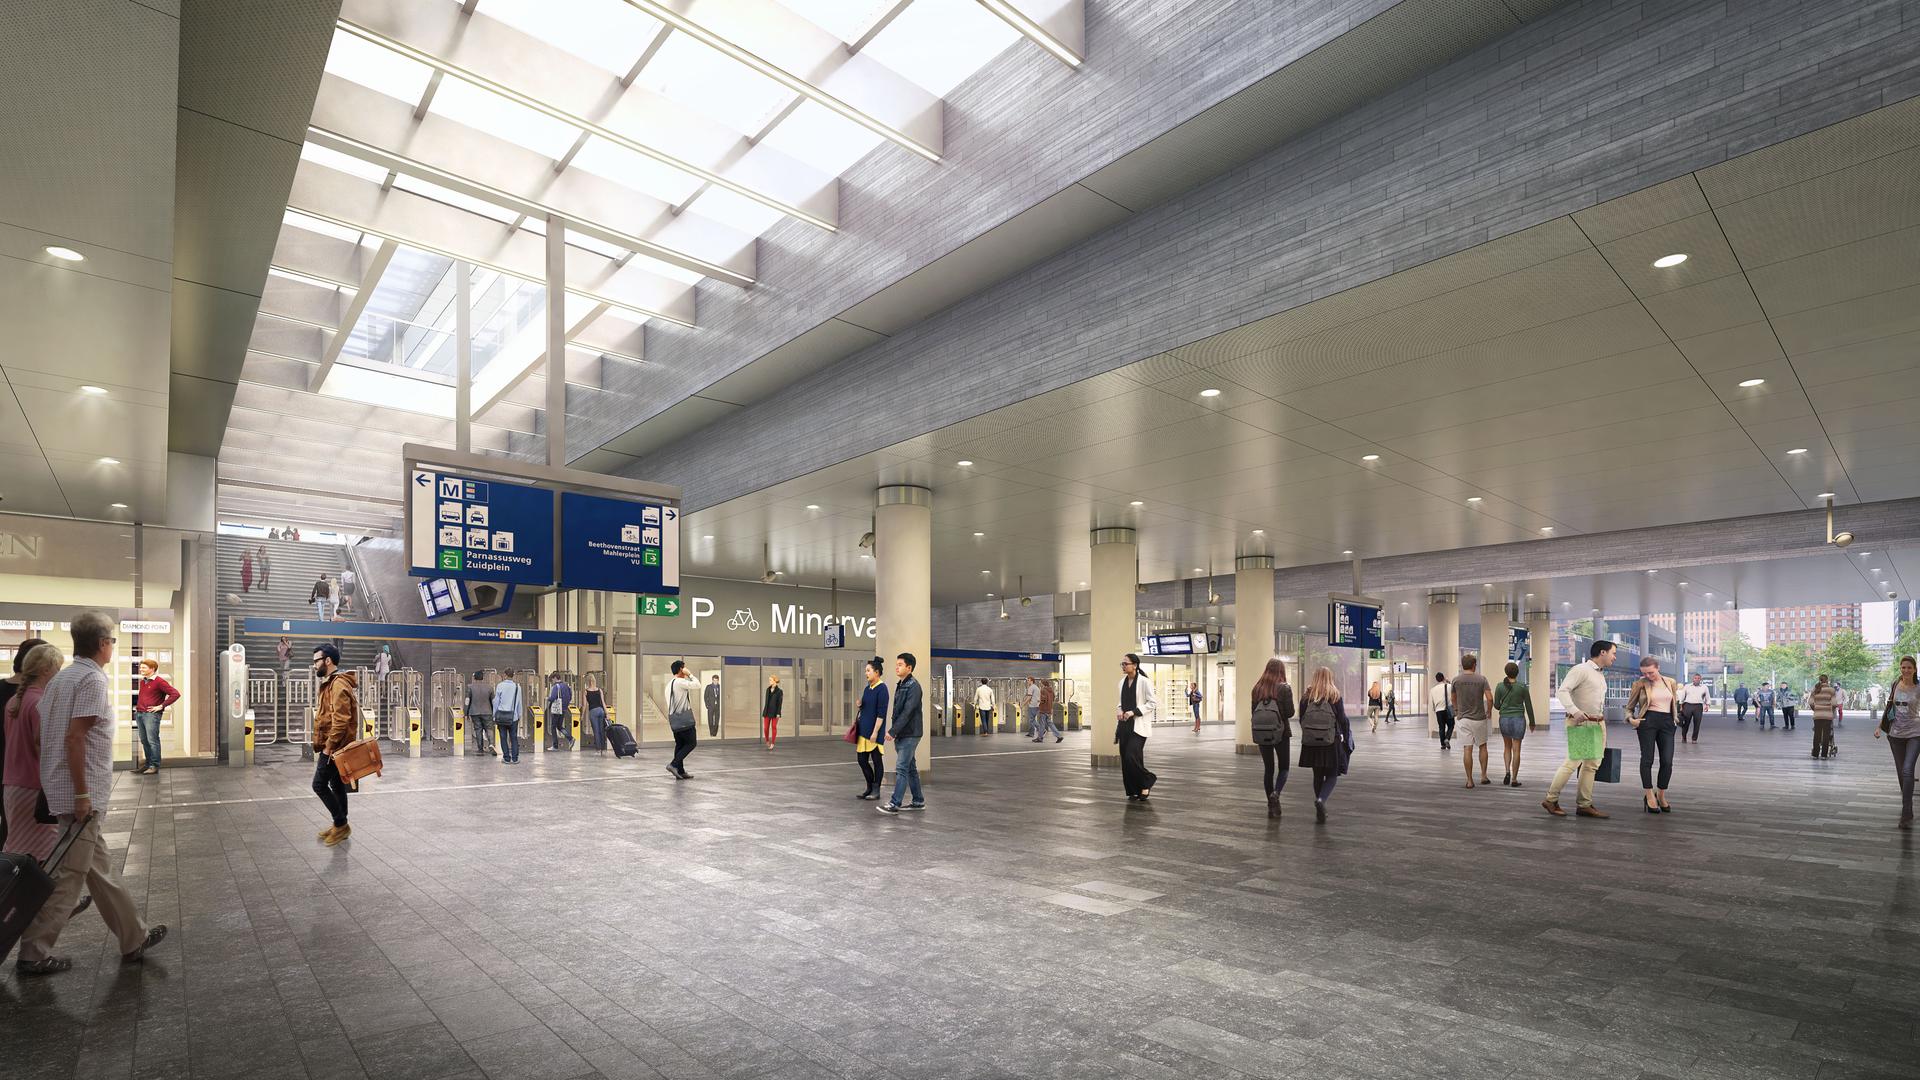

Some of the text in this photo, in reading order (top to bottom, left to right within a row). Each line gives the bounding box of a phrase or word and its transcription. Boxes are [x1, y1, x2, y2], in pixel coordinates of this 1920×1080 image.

[443, 483, 459, 497] M
[0, 532, 41, 560] N
[588, 540, 640, 552] Beethovenstraat
[644, 535, 659, 545] WC
[466, 550, 532, 566] Parnassusweg
[603, 549, 640, 559] Mahlerplein
[466, 560, 511, 572] Zuidplein
[691, 597, 715, 629] P
